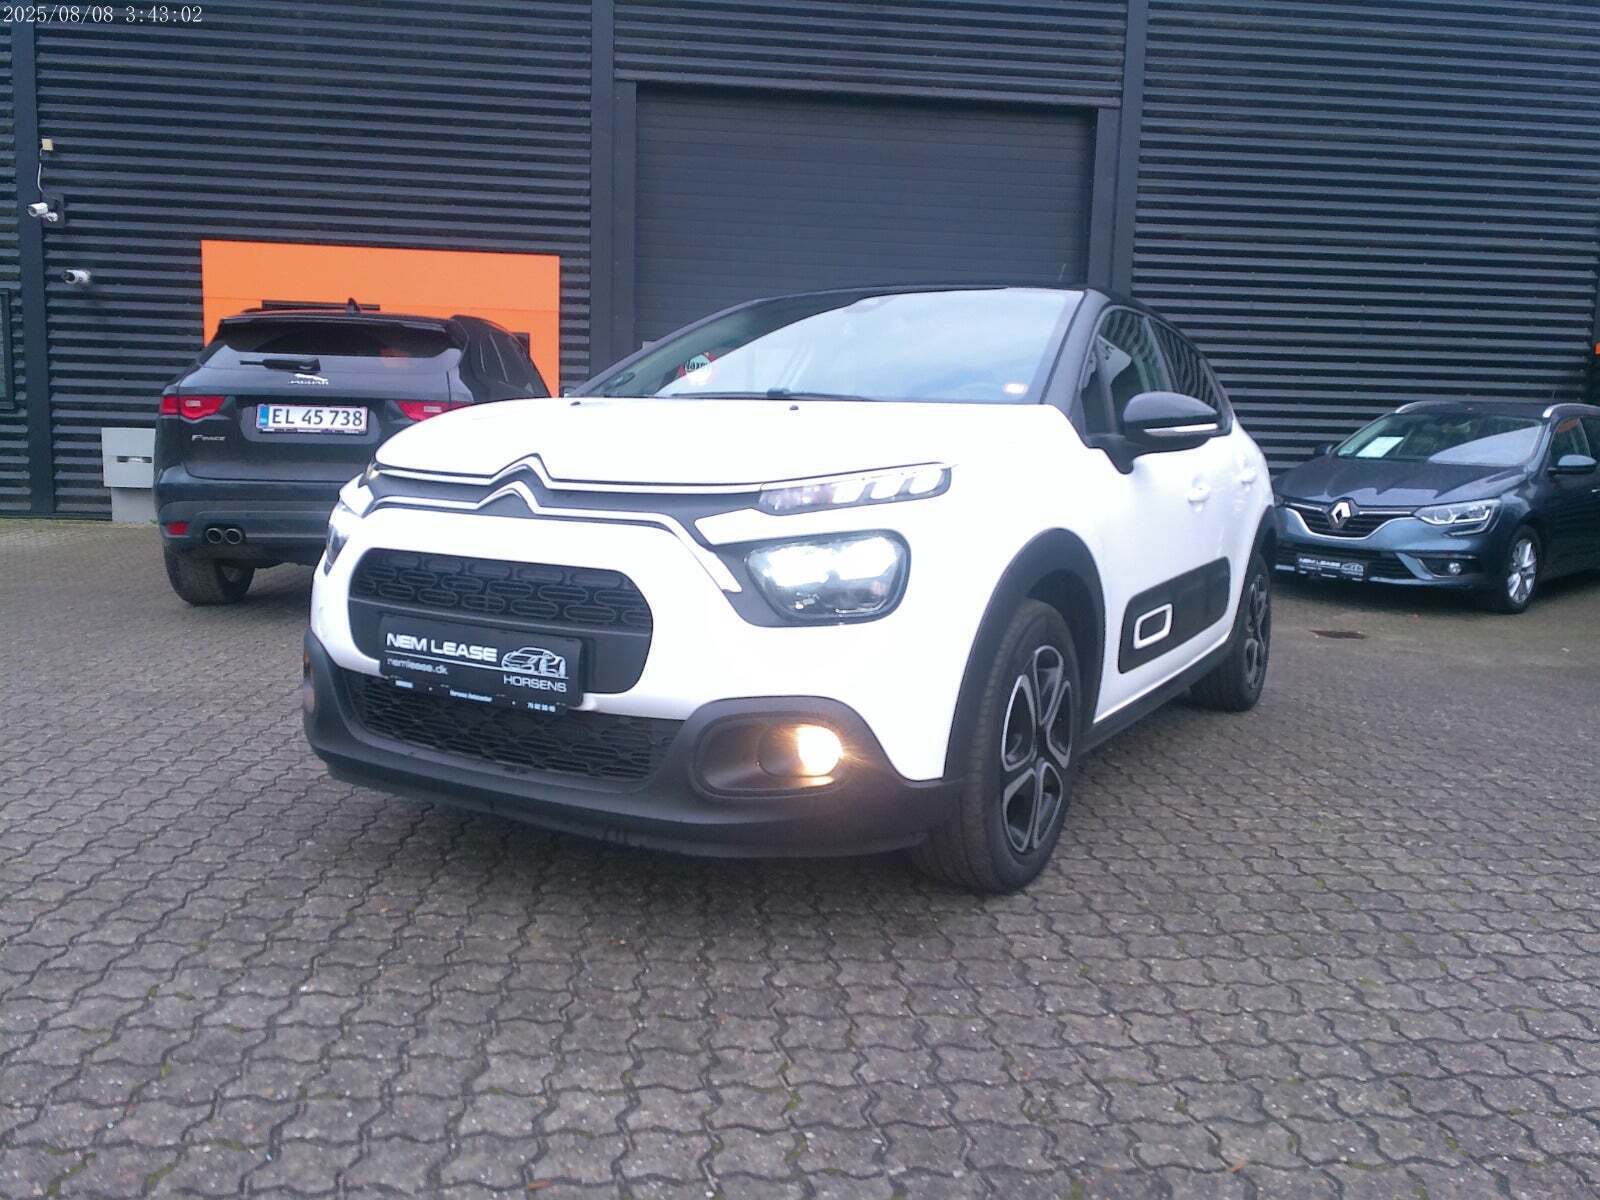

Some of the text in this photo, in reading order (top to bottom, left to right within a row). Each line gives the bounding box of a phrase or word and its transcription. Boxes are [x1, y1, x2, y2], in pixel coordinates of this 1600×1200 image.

[272, 408, 363, 427] EL 45 738
[386, 632, 498, 662] NEM LEASE
[503, 674, 568, 693] HORSENS
